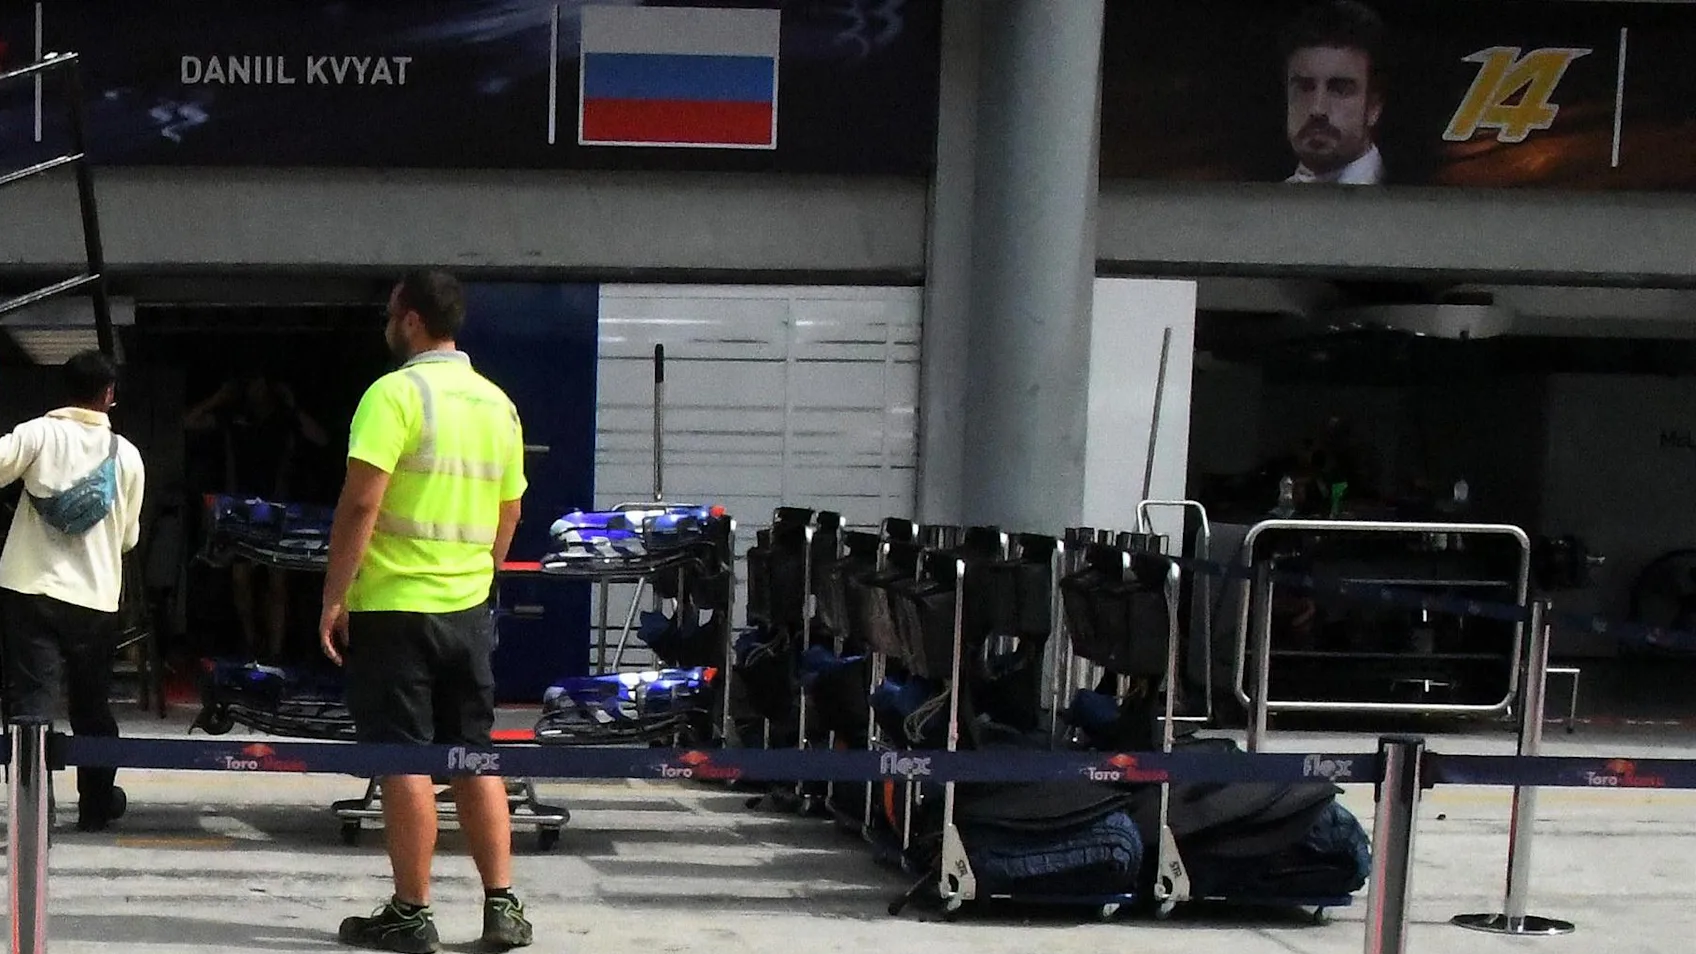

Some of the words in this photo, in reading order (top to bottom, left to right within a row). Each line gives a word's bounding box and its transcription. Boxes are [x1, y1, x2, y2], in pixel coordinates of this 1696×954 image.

[180, 56, 295, 85] DANIIL
[305, 56, 412, 86] KVYAT
[1442, 46, 1593, 142] 14
[225, 756, 258, 770] Toro
[659, 764, 693, 778] Toro
